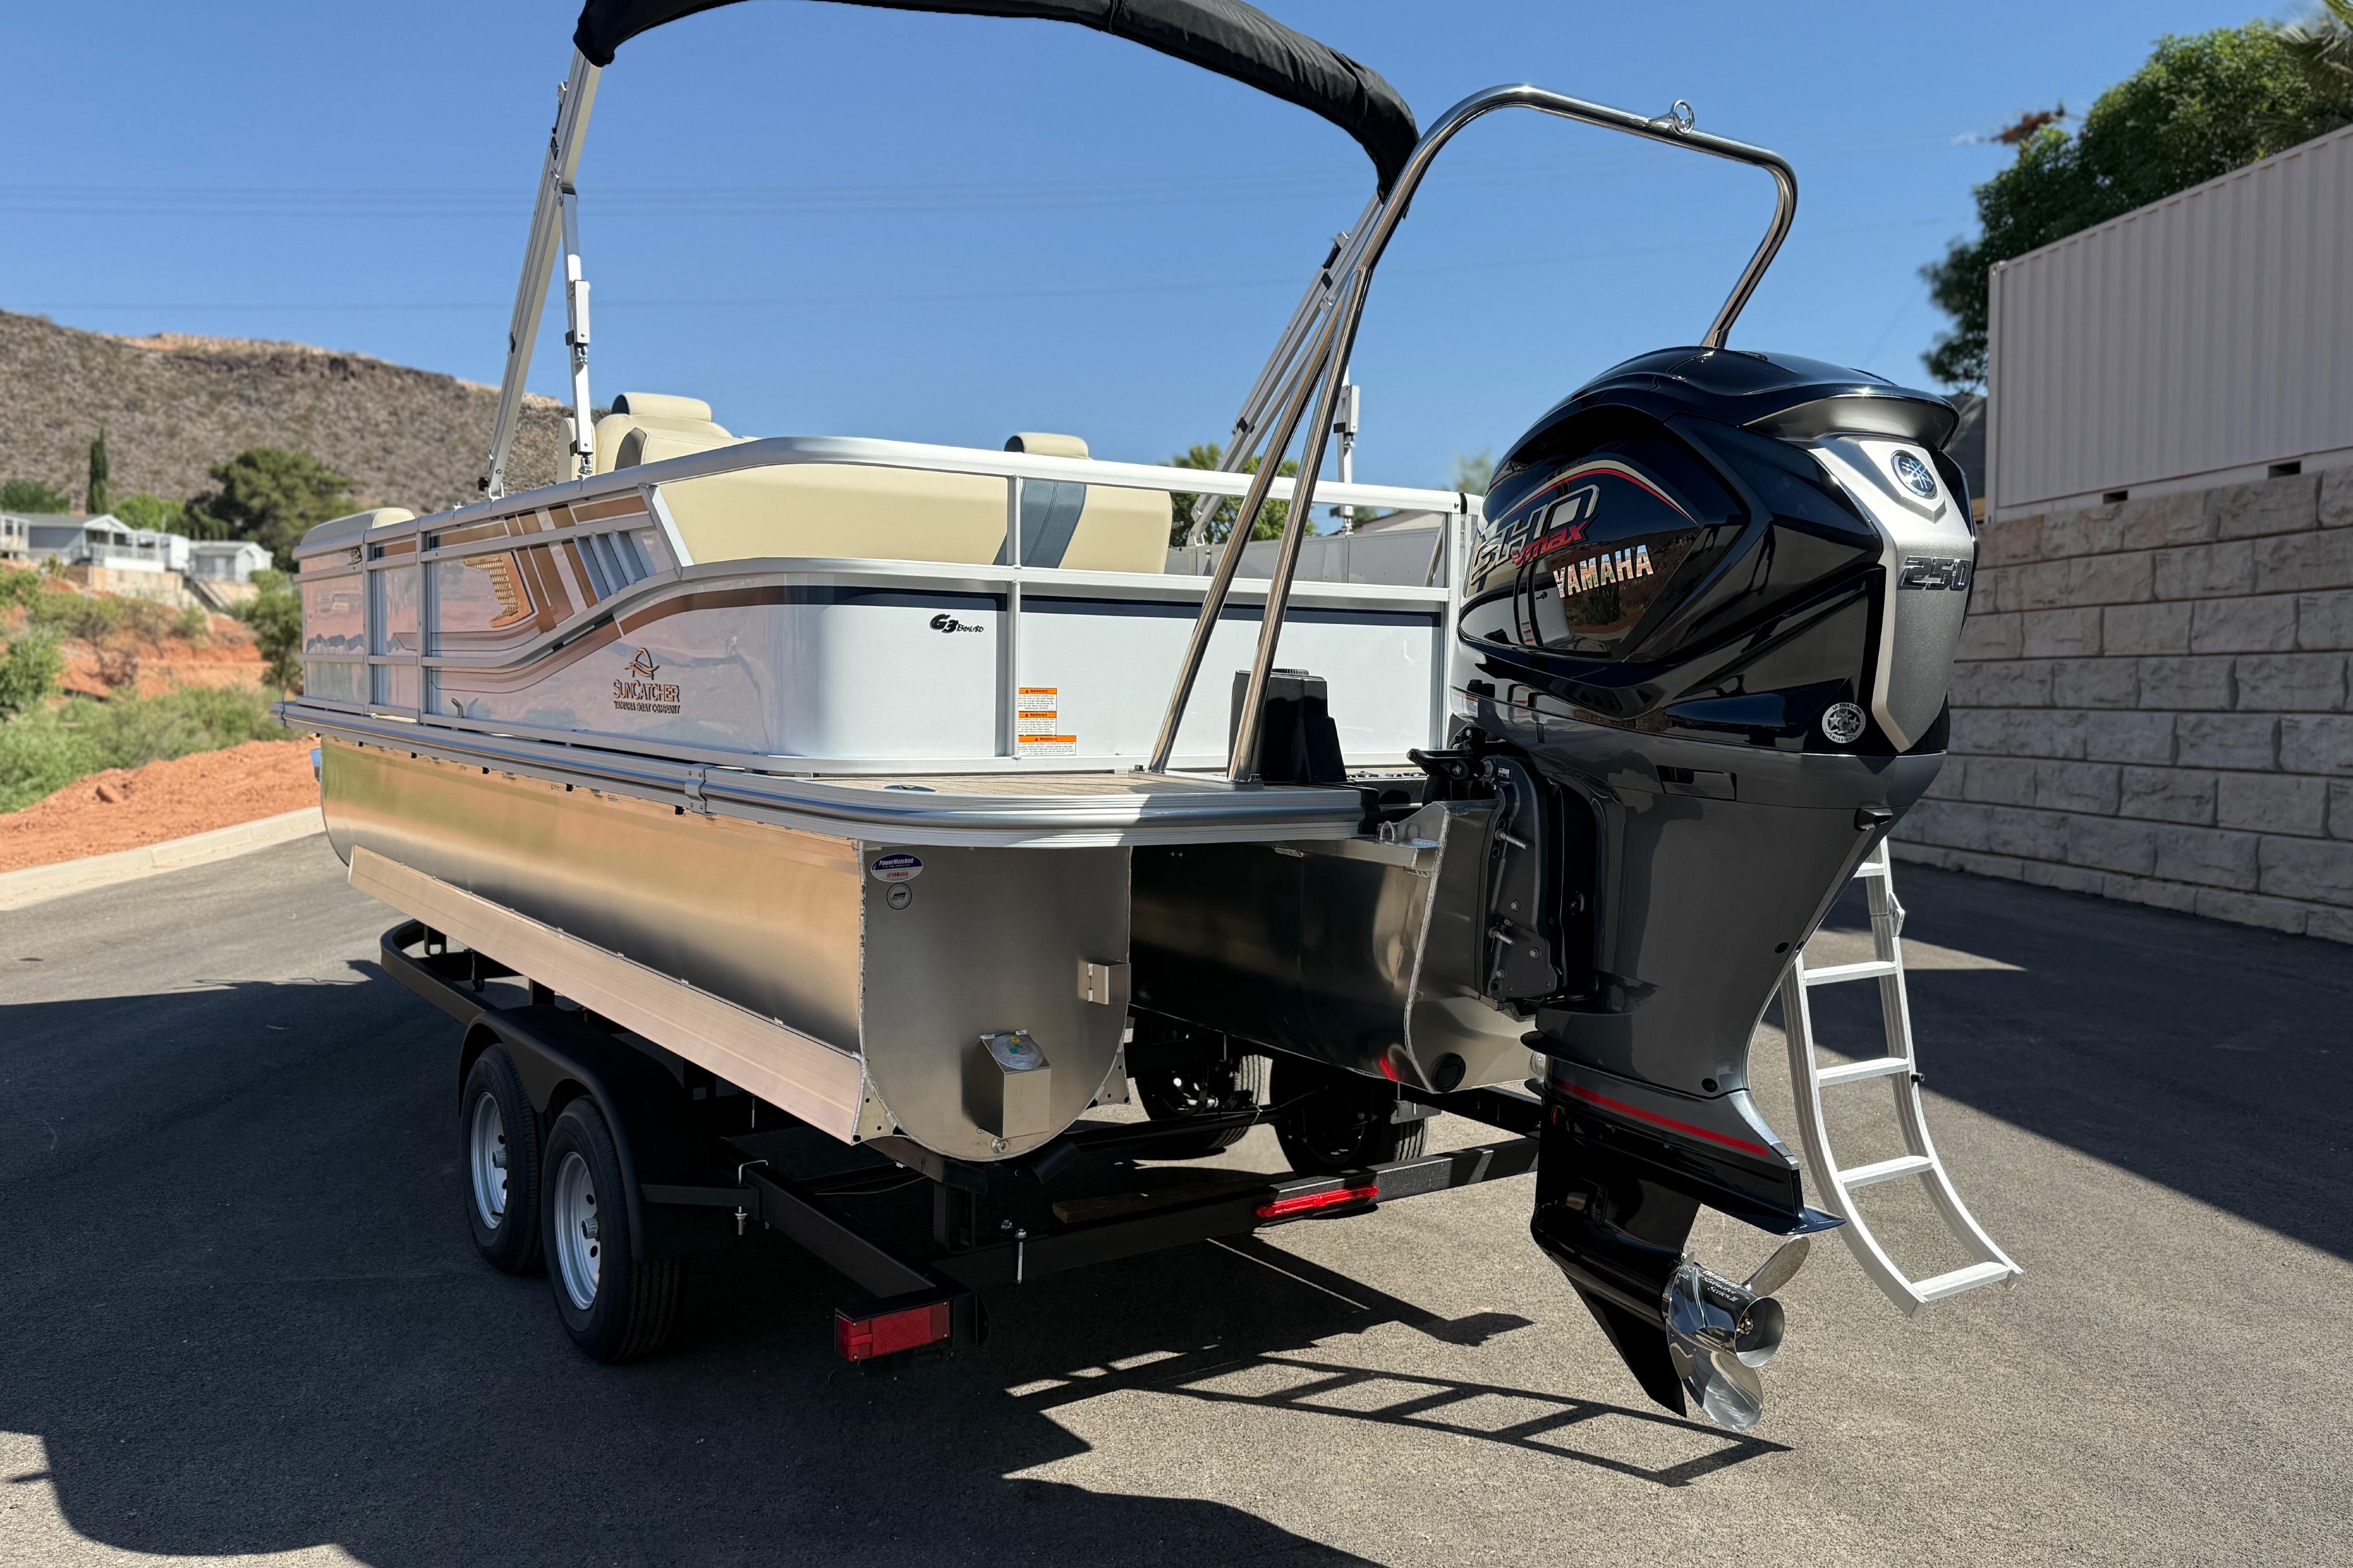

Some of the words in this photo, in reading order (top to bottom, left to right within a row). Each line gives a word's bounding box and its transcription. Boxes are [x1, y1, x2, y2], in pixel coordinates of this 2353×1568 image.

[1553, 544, 1654, 599] YAMAHA
[1897, 556, 1972, 591] 250
[929, 613, 959, 634] G3
[614, 700, 636, 711] YAMAHA
[636, 702, 651, 712] BOAT
[652, 703, 681, 714] COMPANY
